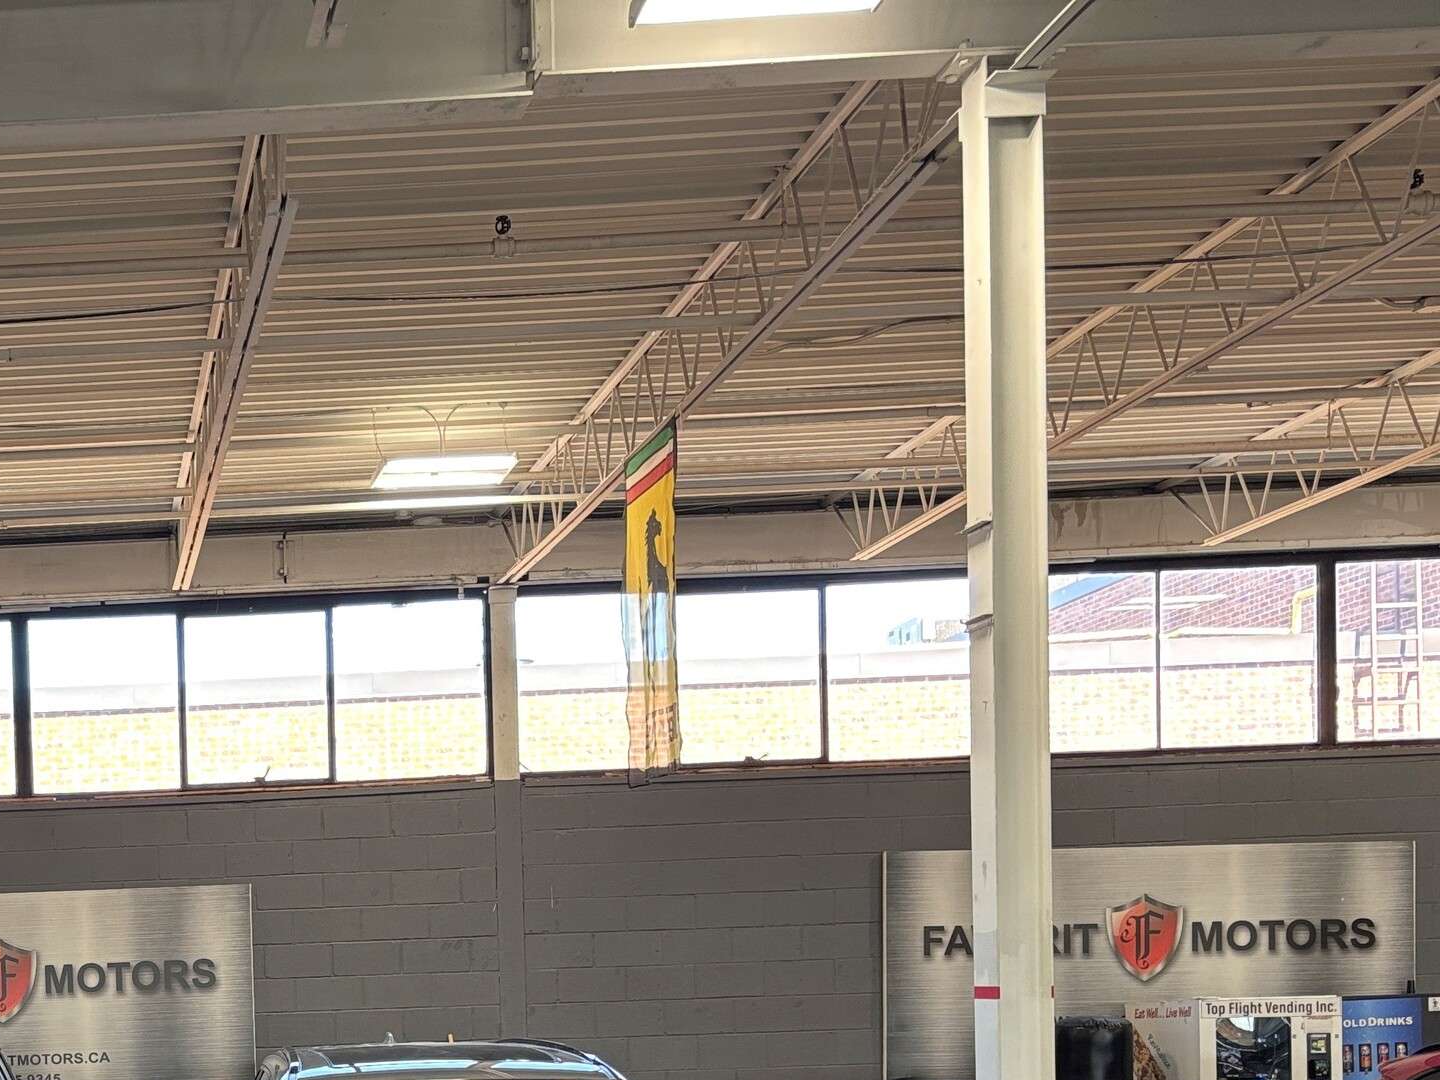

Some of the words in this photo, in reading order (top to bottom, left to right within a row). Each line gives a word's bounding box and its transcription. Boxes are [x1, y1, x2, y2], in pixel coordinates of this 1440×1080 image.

[923, 922, 1098, 956] FAIT
[1191, 917, 1376, 953] MOTORS
[44, 958, 217, 994] MOTORS
[1206, 1002, 1225, 1016] Top
[1229, 1002, 1262, 1016] Flight
[1265, 1001, 1312, 1015] Vending
[1316, 1001, 1337, 1013] Inc.
[1343, 1018, 1367, 1028] OLD
[1368, 1016, 1414, 1027] DRINKS
[7, 1051, 111, 1066] TMOTORS.CA
